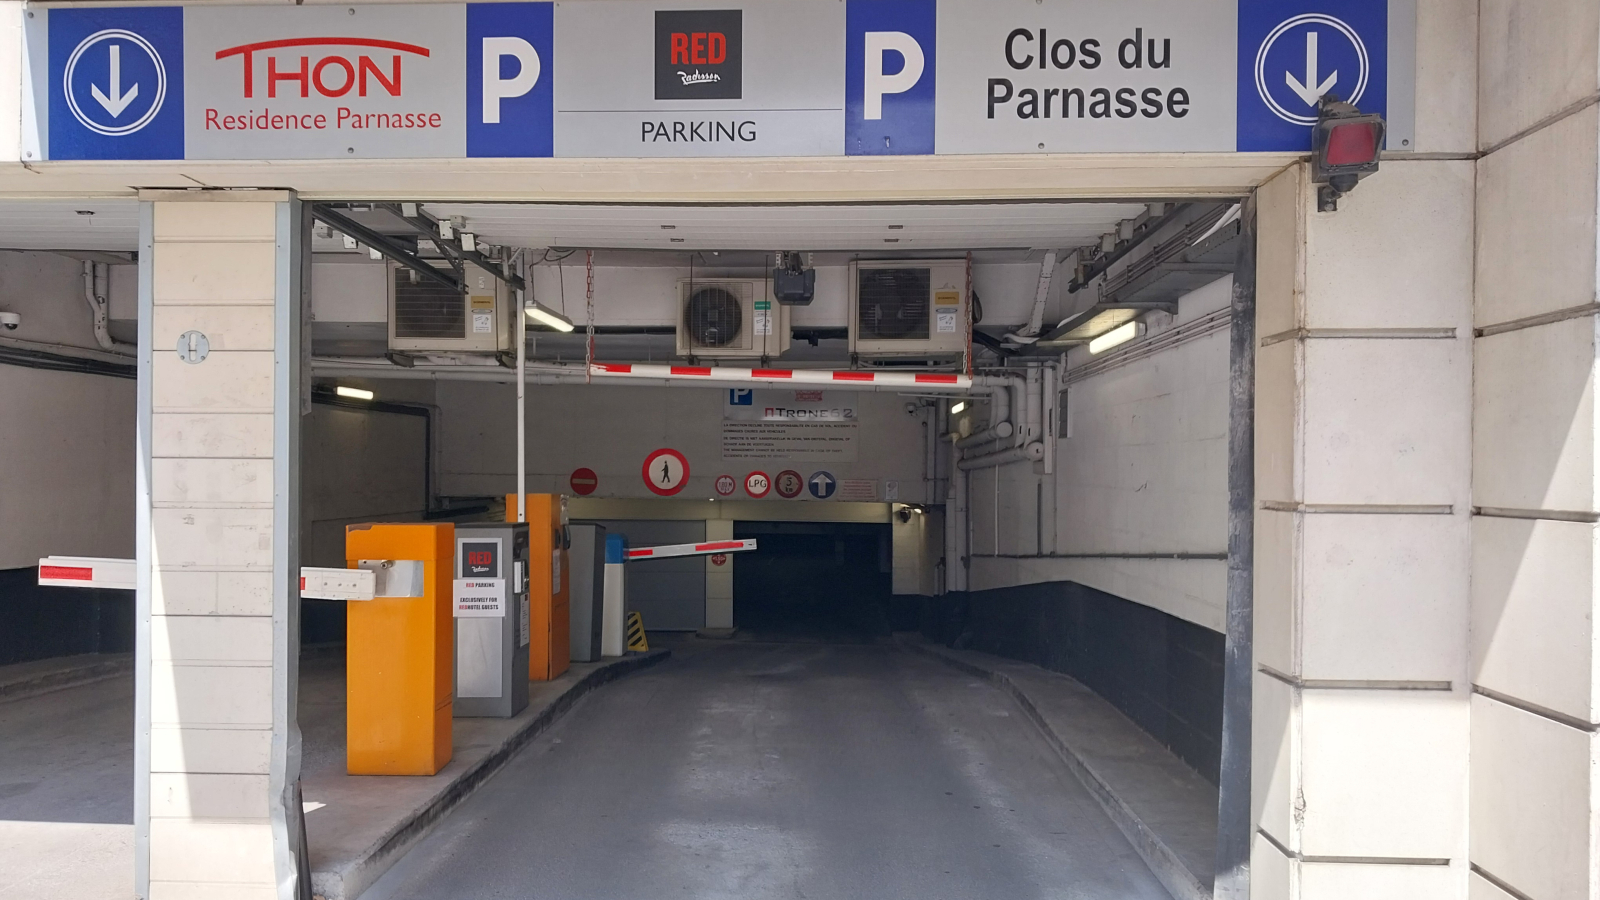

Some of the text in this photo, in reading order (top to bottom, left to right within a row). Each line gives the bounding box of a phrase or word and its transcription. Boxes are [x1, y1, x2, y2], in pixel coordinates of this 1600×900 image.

[671, 33, 726, 64] RED
[1005, 28, 1171, 69] Clos du
[216, 37, 429, 98] THON
[483, 37, 540, 123] P
[677, 69, 721, 85] Radisson
[864, 31, 924, 120] P
[988, 79, 1190, 119] Parnasse
[206, 107, 441, 130] Residence Parnasse
[642, 121, 756, 142] PARKING
[748, 480, 767, 488] LPG
[786, 477, 792, 486] 5
[468, 551, 492, 564] RED
